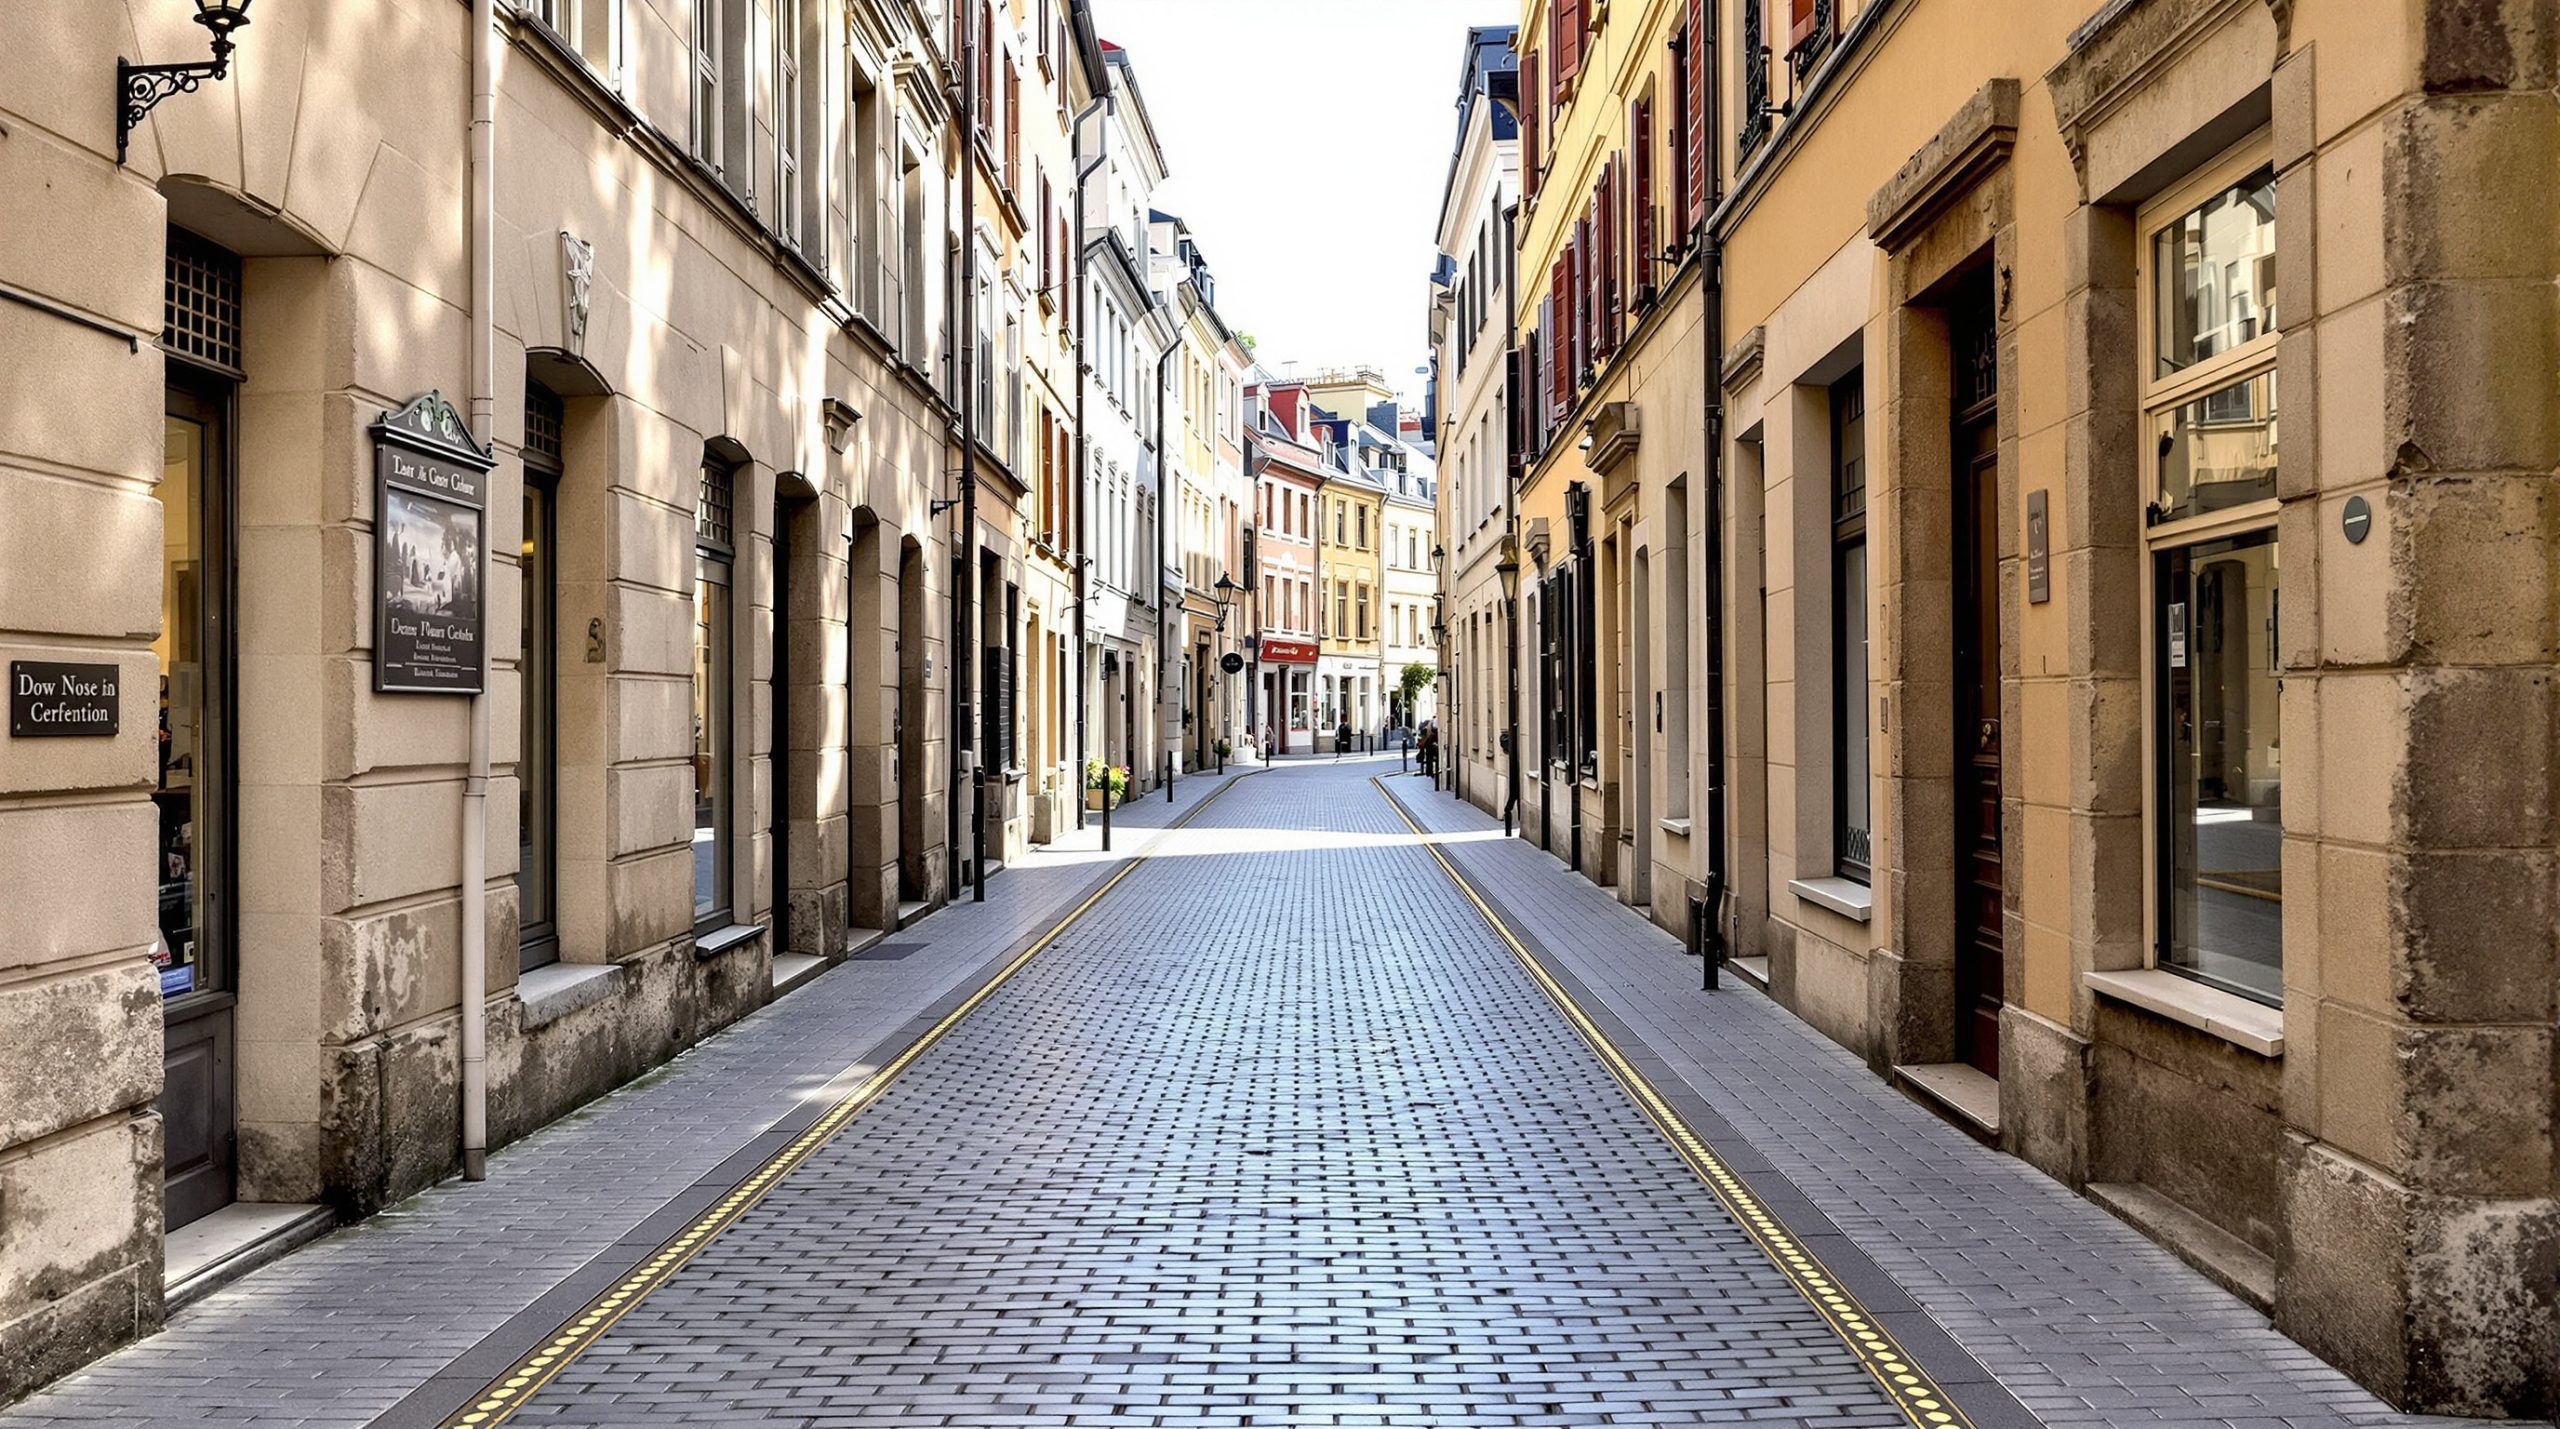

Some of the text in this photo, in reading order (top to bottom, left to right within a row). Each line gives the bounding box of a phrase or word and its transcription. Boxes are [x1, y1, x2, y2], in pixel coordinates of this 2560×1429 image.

[18, 674, 116, 696] Dow Nose in
[30, 701, 108, 722] Cerfention
